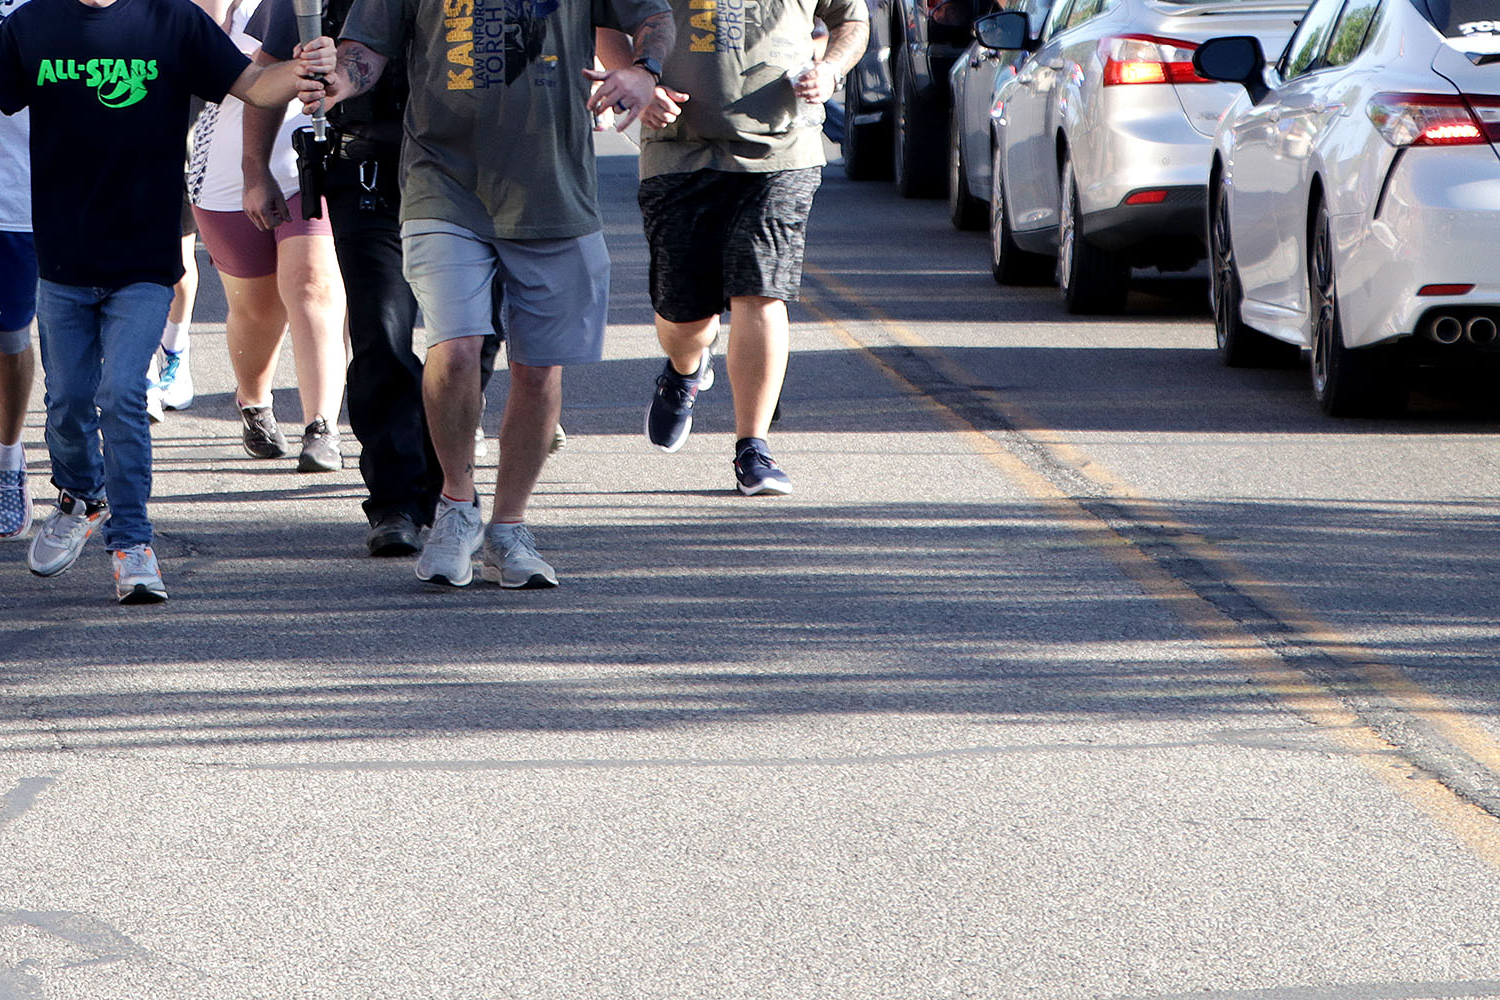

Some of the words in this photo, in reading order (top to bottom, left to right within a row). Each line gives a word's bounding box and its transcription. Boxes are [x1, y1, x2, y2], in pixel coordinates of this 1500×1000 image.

[484, 7, 504, 89] TORCH
[37, 58, 159, 87] ALL-STARS
[475, 58, 486, 89] LAW
